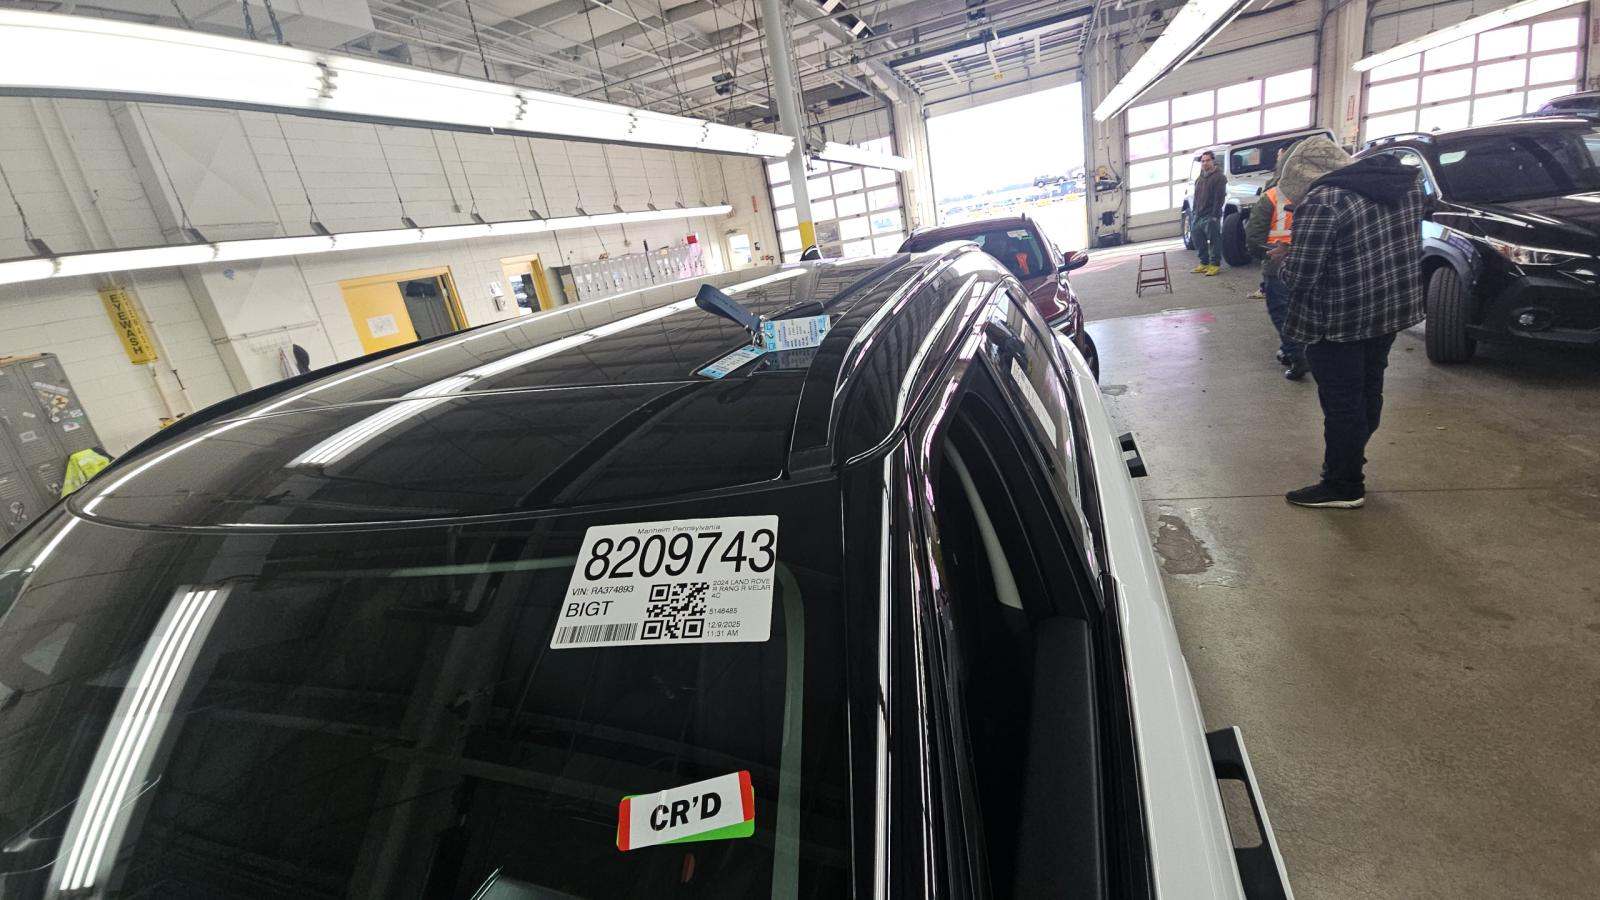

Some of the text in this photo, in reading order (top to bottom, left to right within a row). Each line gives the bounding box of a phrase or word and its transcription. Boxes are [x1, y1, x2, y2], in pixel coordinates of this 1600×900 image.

[109, 294, 143, 355] EYEWASH
[637, 524, 721, 535] Manheim Pennsylvania
[584, 528, 776, 581] 8209743
[730, 578, 750, 586] LAND
[572, 584, 635, 596] VIN: RA374893
[565, 600, 614, 618] BIGT
[706, 629, 739, 638] 11:31 AM
[650, 792, 722, 832] CR'D
